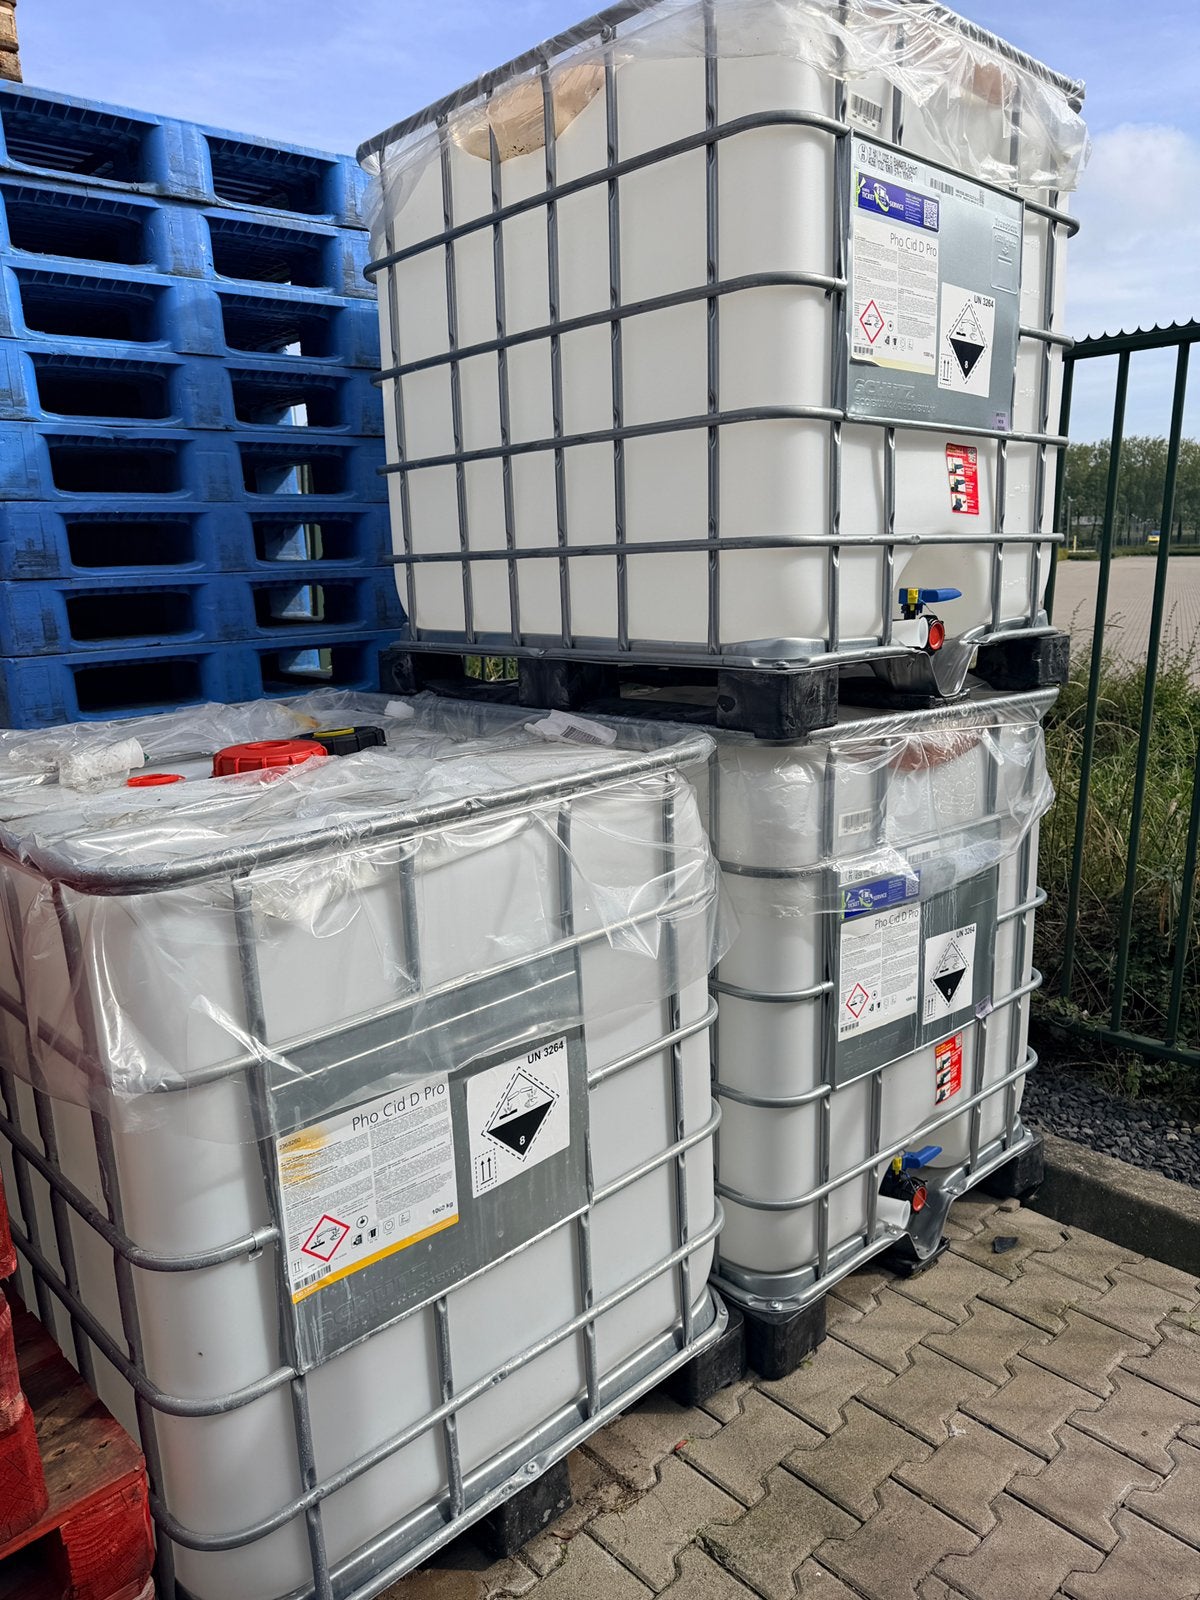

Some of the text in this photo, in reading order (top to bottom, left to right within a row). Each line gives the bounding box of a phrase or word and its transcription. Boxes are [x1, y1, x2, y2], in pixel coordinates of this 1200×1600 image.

[861, 192, 904, 210] TICKET SERVICE
[890, 233, 904, 247] Pho
[905, 237, 917, 251] Cid
[919, 241, 925, 253] D
[926, 243, 937, 257] Pro
[974, 295, 994, 309] UN 3264
[964, 360, 969, 369] 8
[874, 909, 919, 929] Pho Cid D Pro
[956, 926, 975, 939] UN 3264
[947, 987, 952, 996] 8
[527, 1040, 564, 1064] UN 3264
[351, 1083, 445, 1132] Pho Cid D Pro
[519, 1135, 526, 1146] 8
